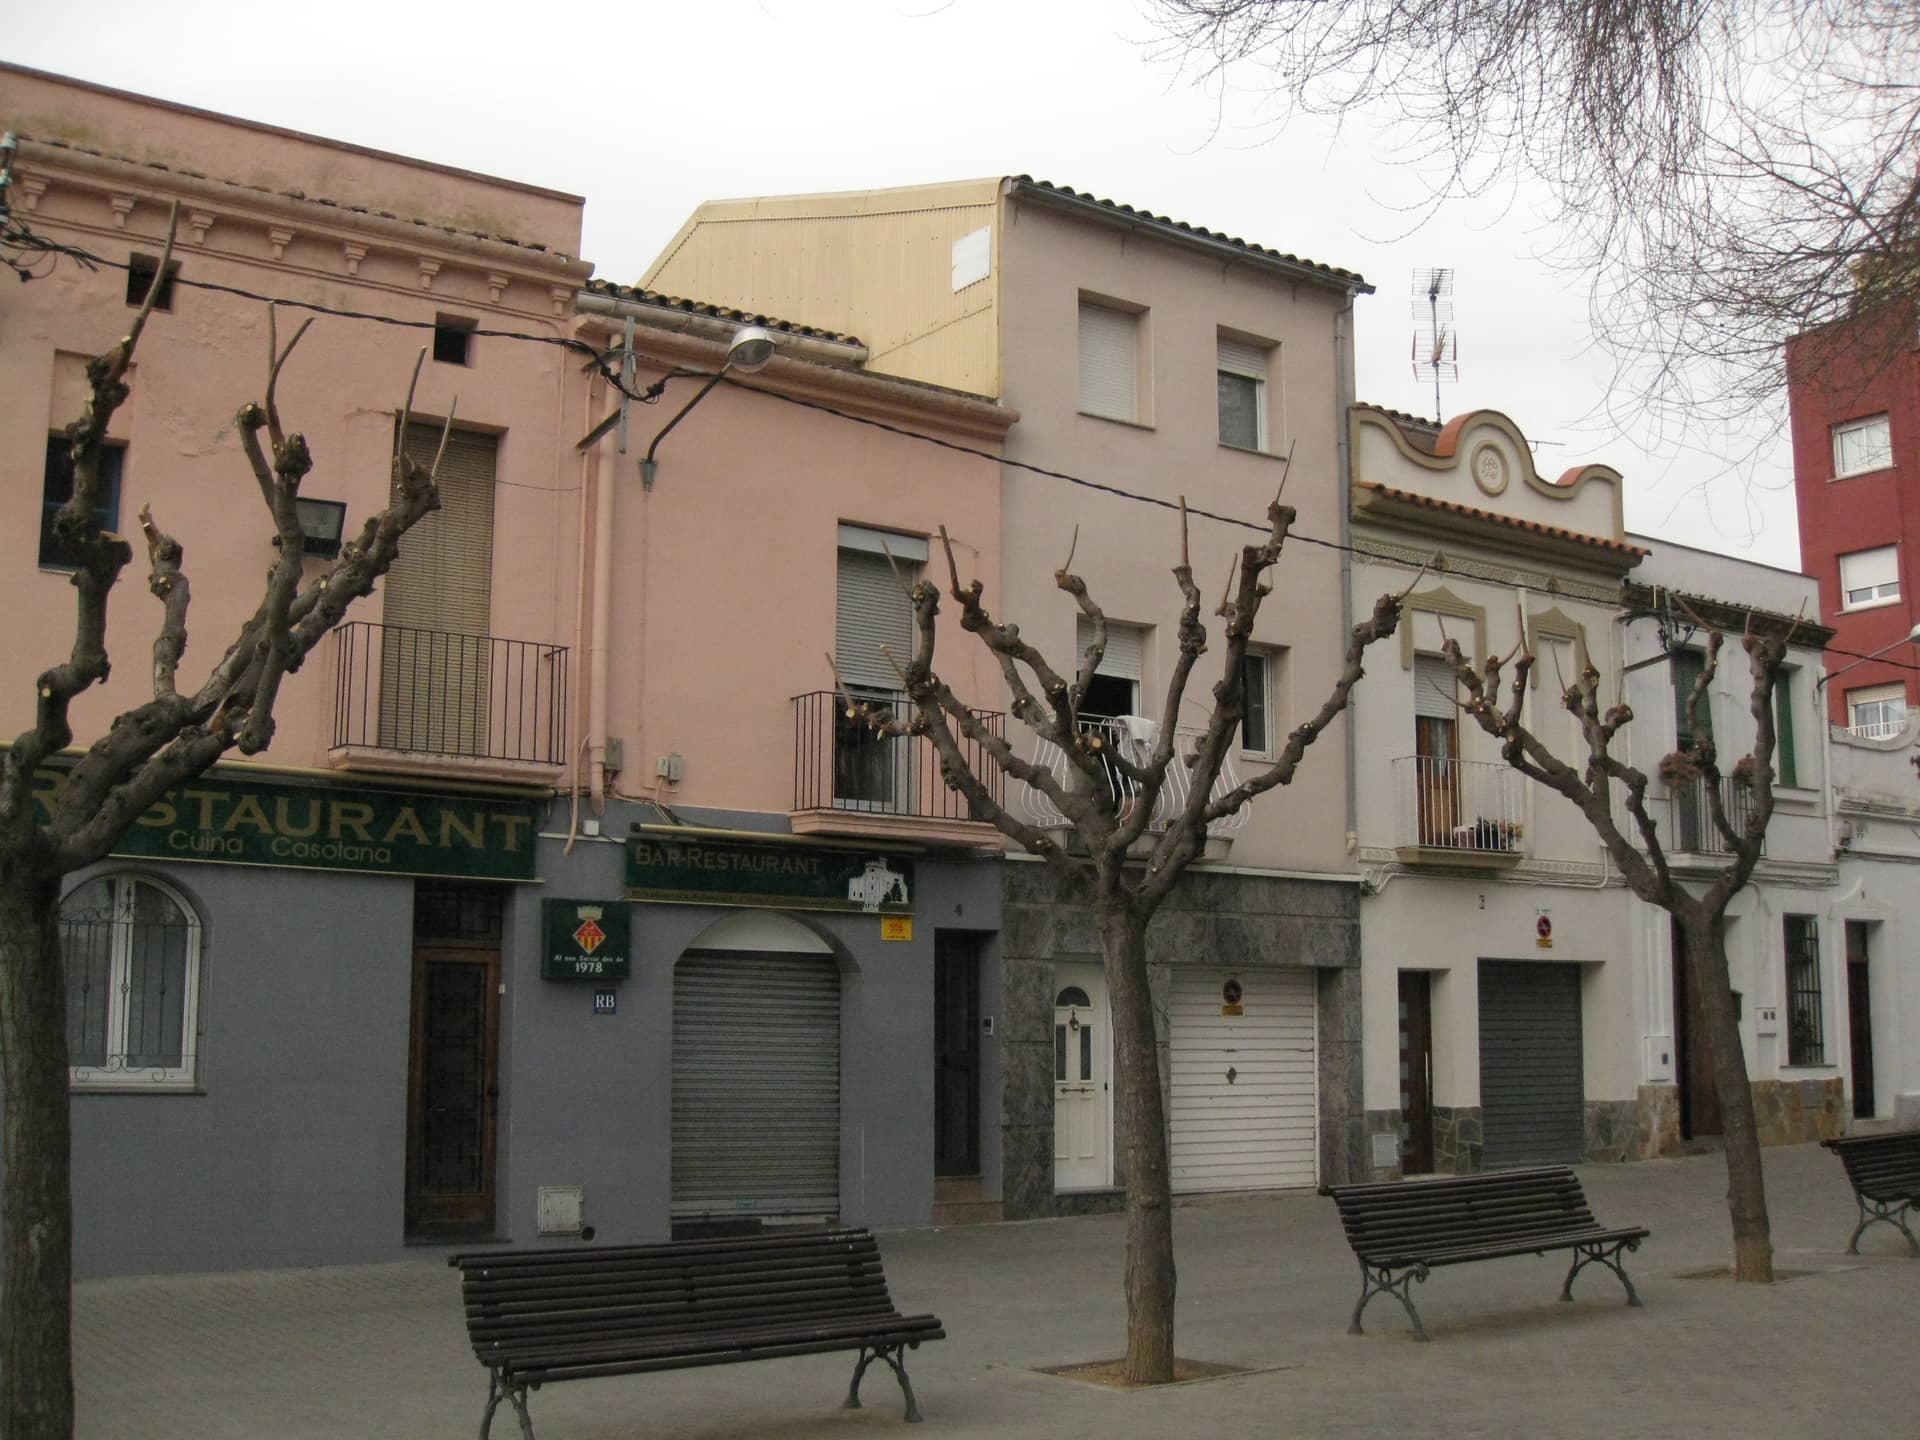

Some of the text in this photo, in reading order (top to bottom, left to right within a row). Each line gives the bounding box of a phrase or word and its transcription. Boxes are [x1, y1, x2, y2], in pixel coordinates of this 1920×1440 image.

[168, 829, 391, 864] Cuina Casolana
[575, 962, 603, 973] 1978
[595, 994, 615, 1009] RB
